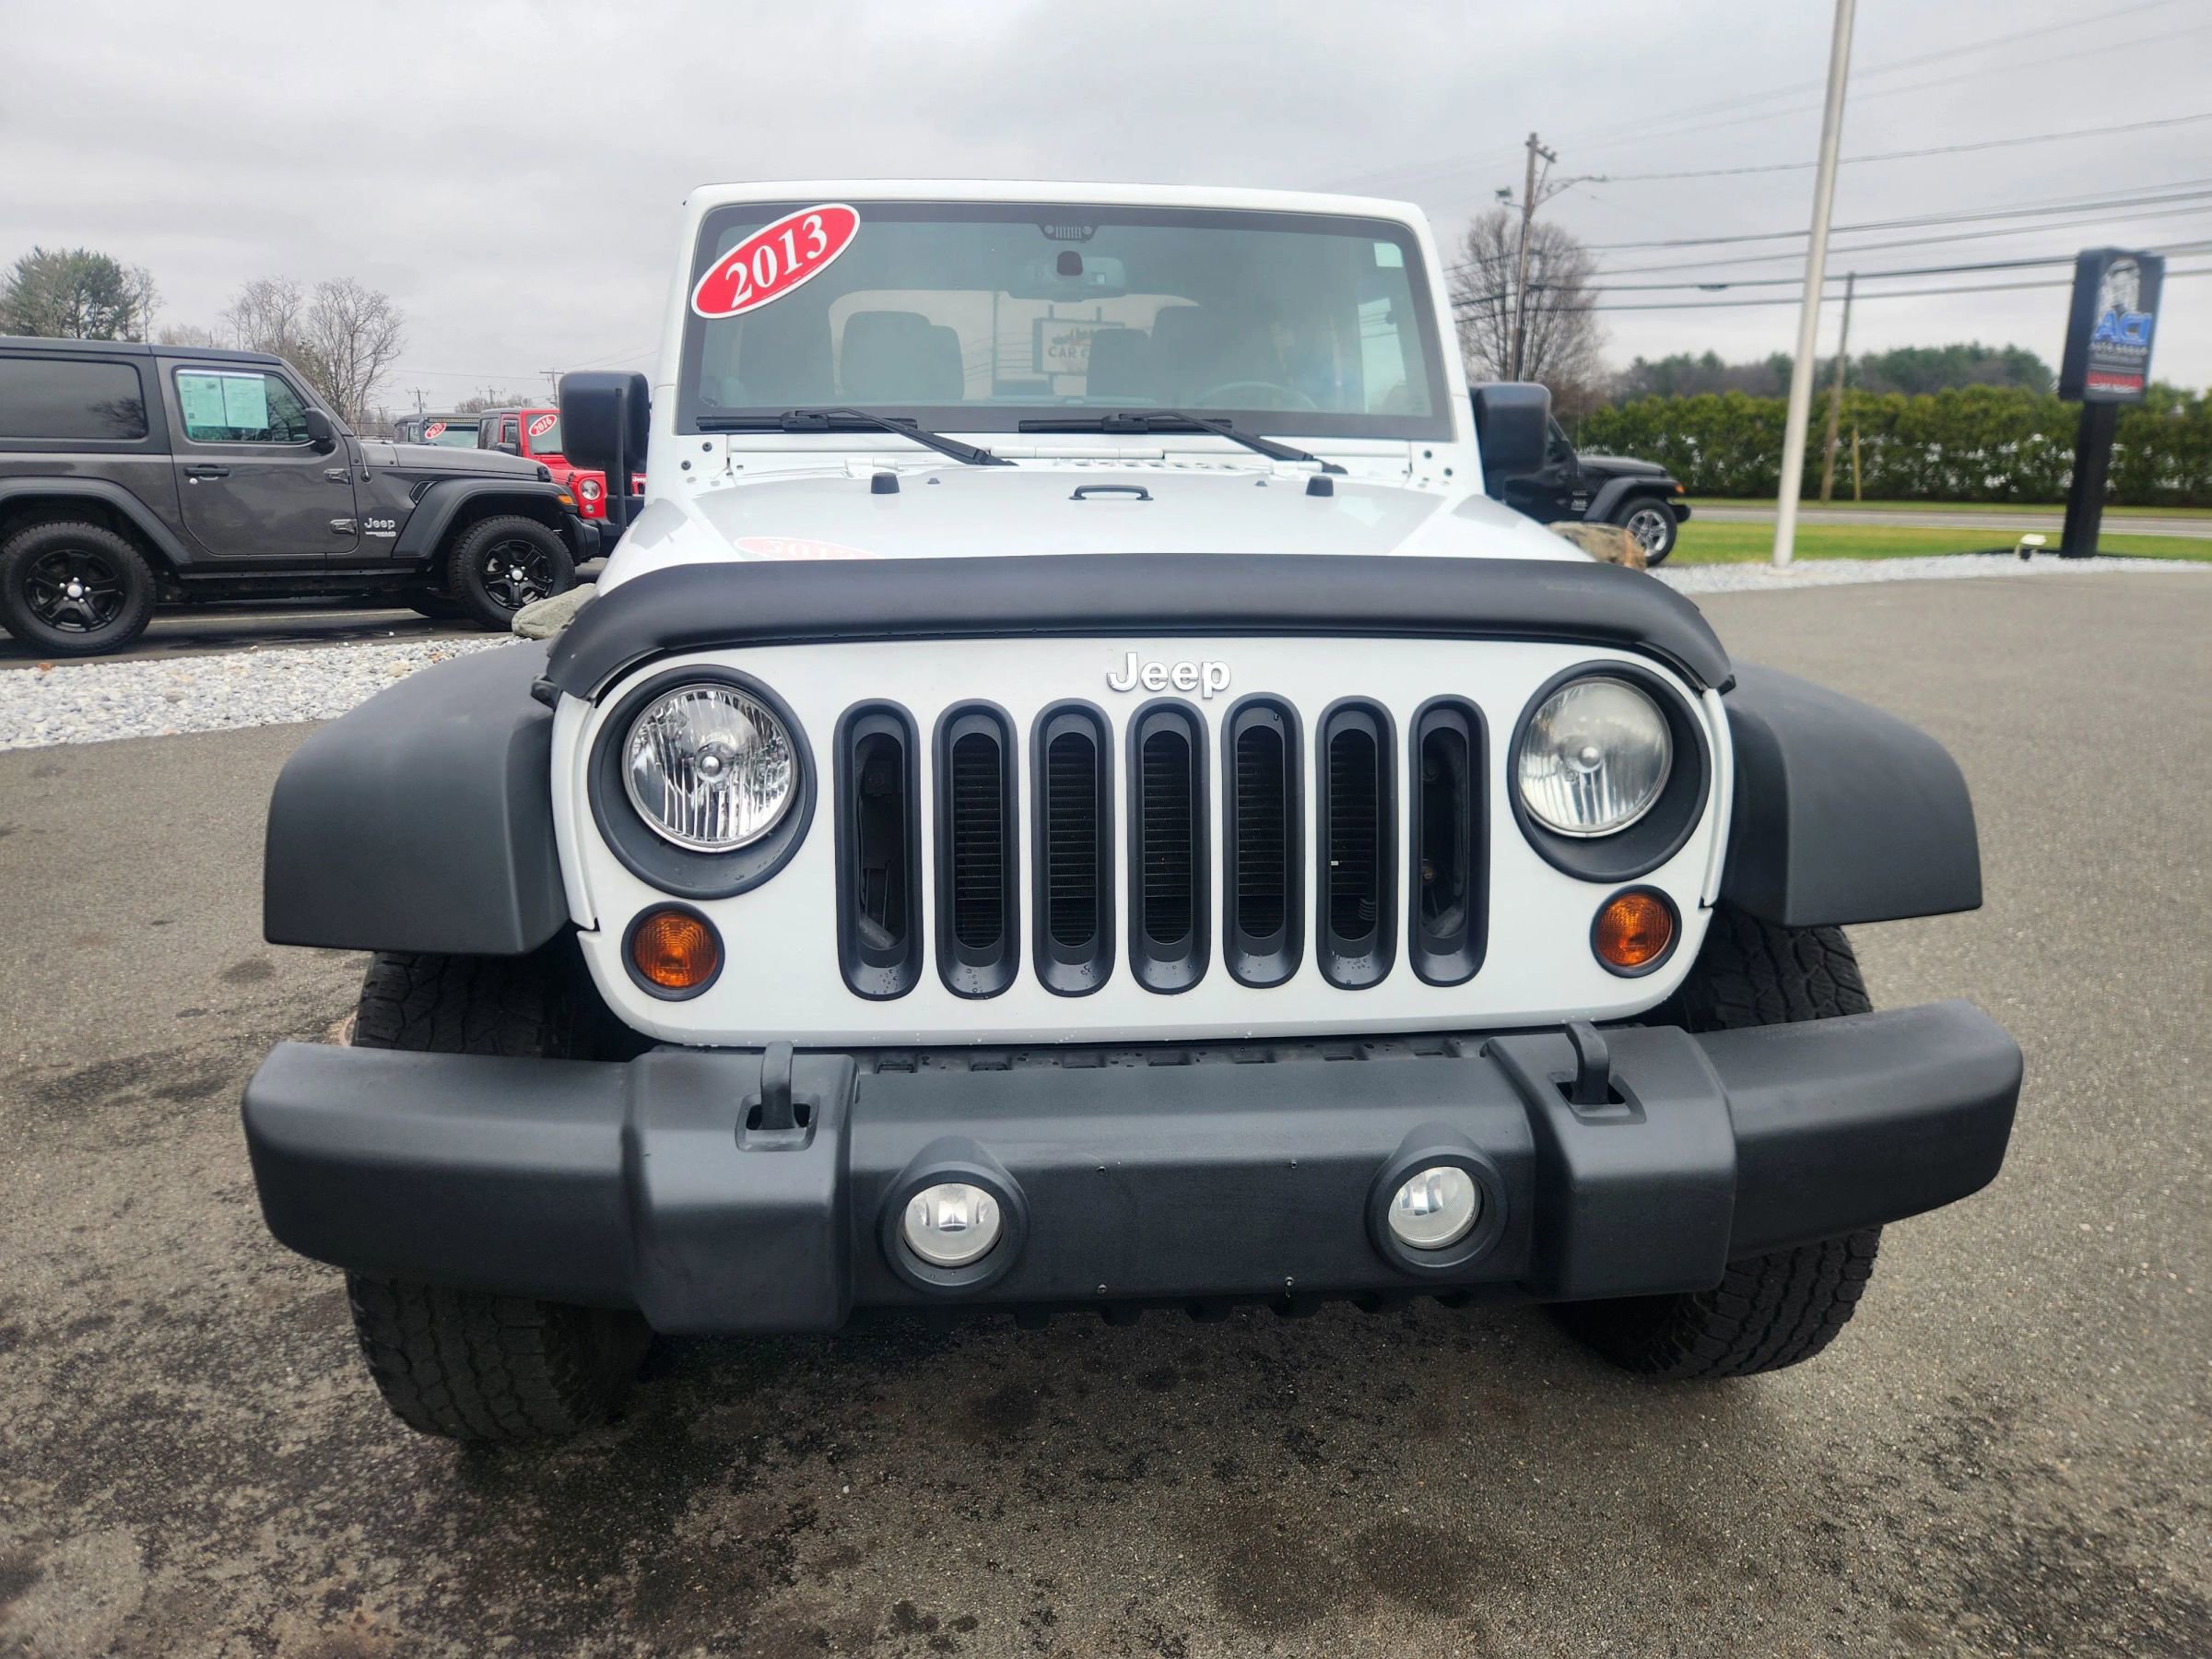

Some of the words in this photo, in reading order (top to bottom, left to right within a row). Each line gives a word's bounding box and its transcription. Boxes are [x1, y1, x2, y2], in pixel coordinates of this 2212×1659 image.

[725, 214, 828, 309] 2013
[534, 418, 552, 432] 2016
[364, 517, 395, 530] Jeep
[1106, 651, 1231, 700] Jeep
